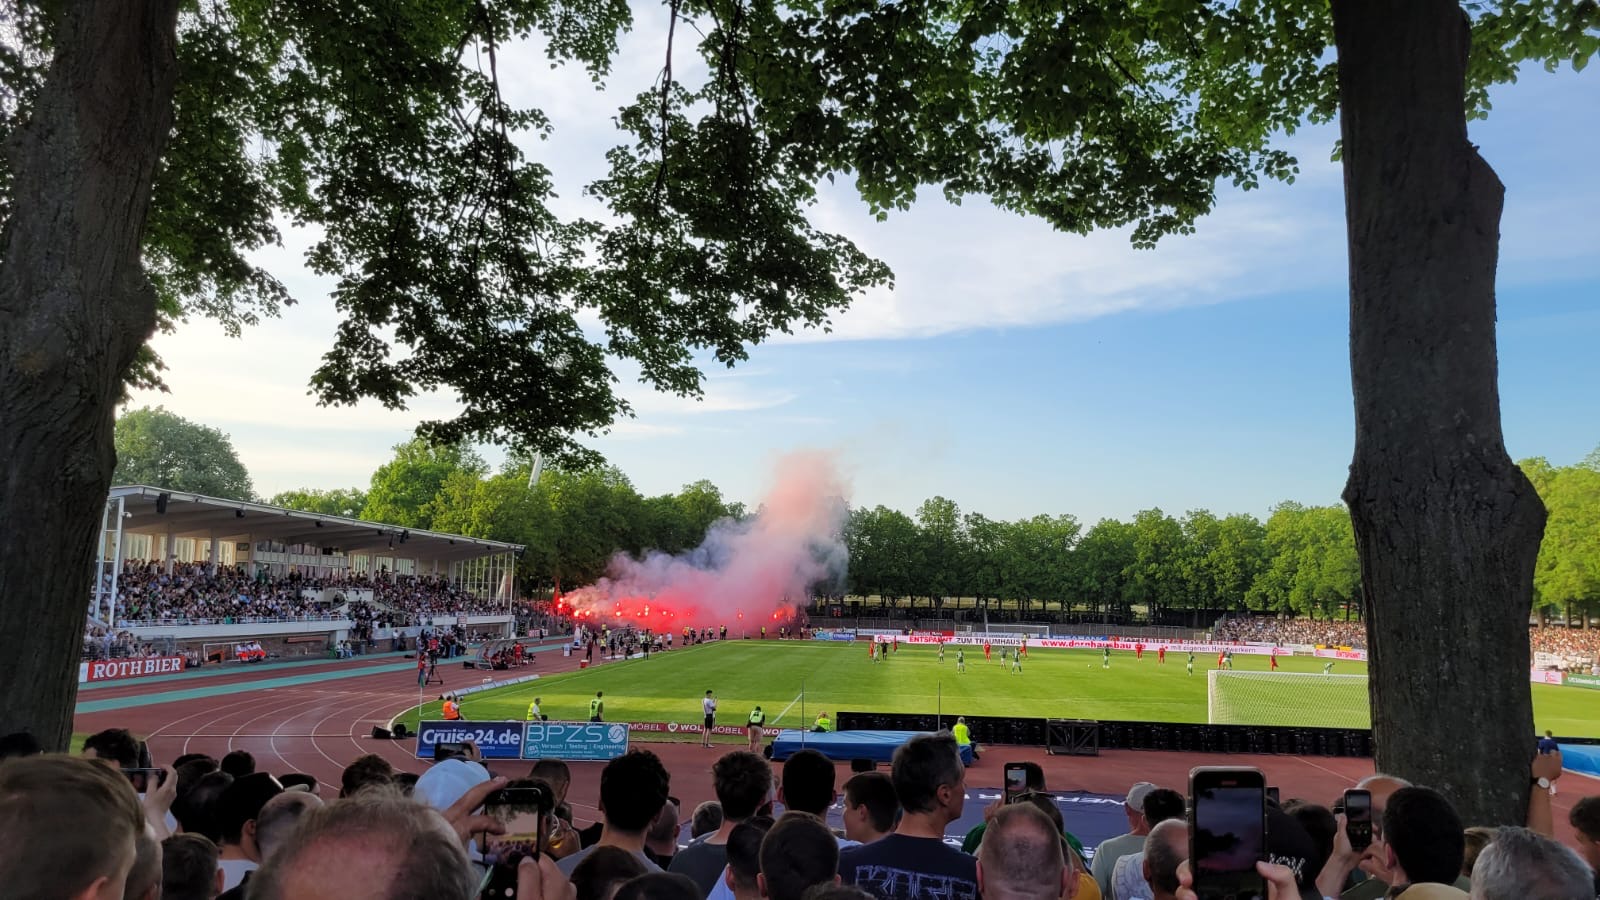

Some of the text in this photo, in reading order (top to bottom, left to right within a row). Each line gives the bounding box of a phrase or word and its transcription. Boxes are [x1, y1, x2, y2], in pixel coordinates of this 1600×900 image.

[1041, 640, 1146, 650] www.dornhausbaue
[93, 658, 181, 678] ROTH BIER
[423, 729, 520, 745] Cruise24.de
[526, 725, 603, 742] BPZS
